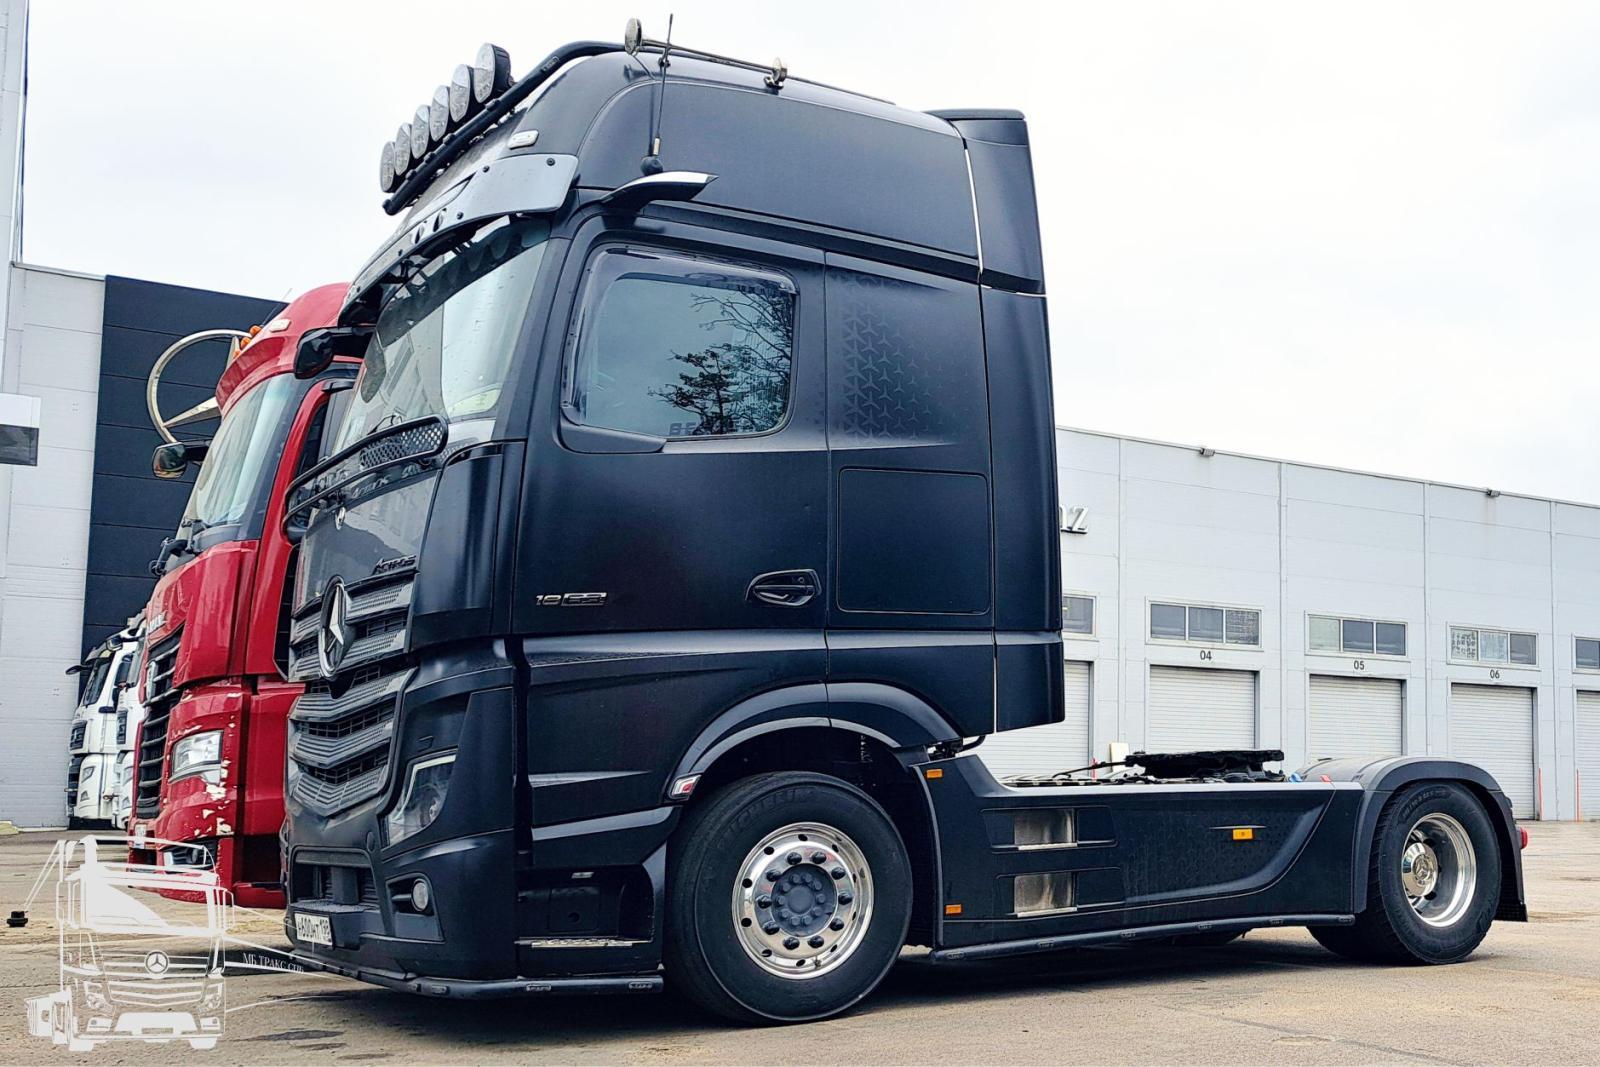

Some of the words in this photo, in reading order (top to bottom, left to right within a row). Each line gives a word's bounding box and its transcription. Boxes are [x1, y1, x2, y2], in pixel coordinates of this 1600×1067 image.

[1200, 650, 1212, 661] 04
[1353, 660, 1365, 670] 05
[1489, 669, 1500, 679] 06
